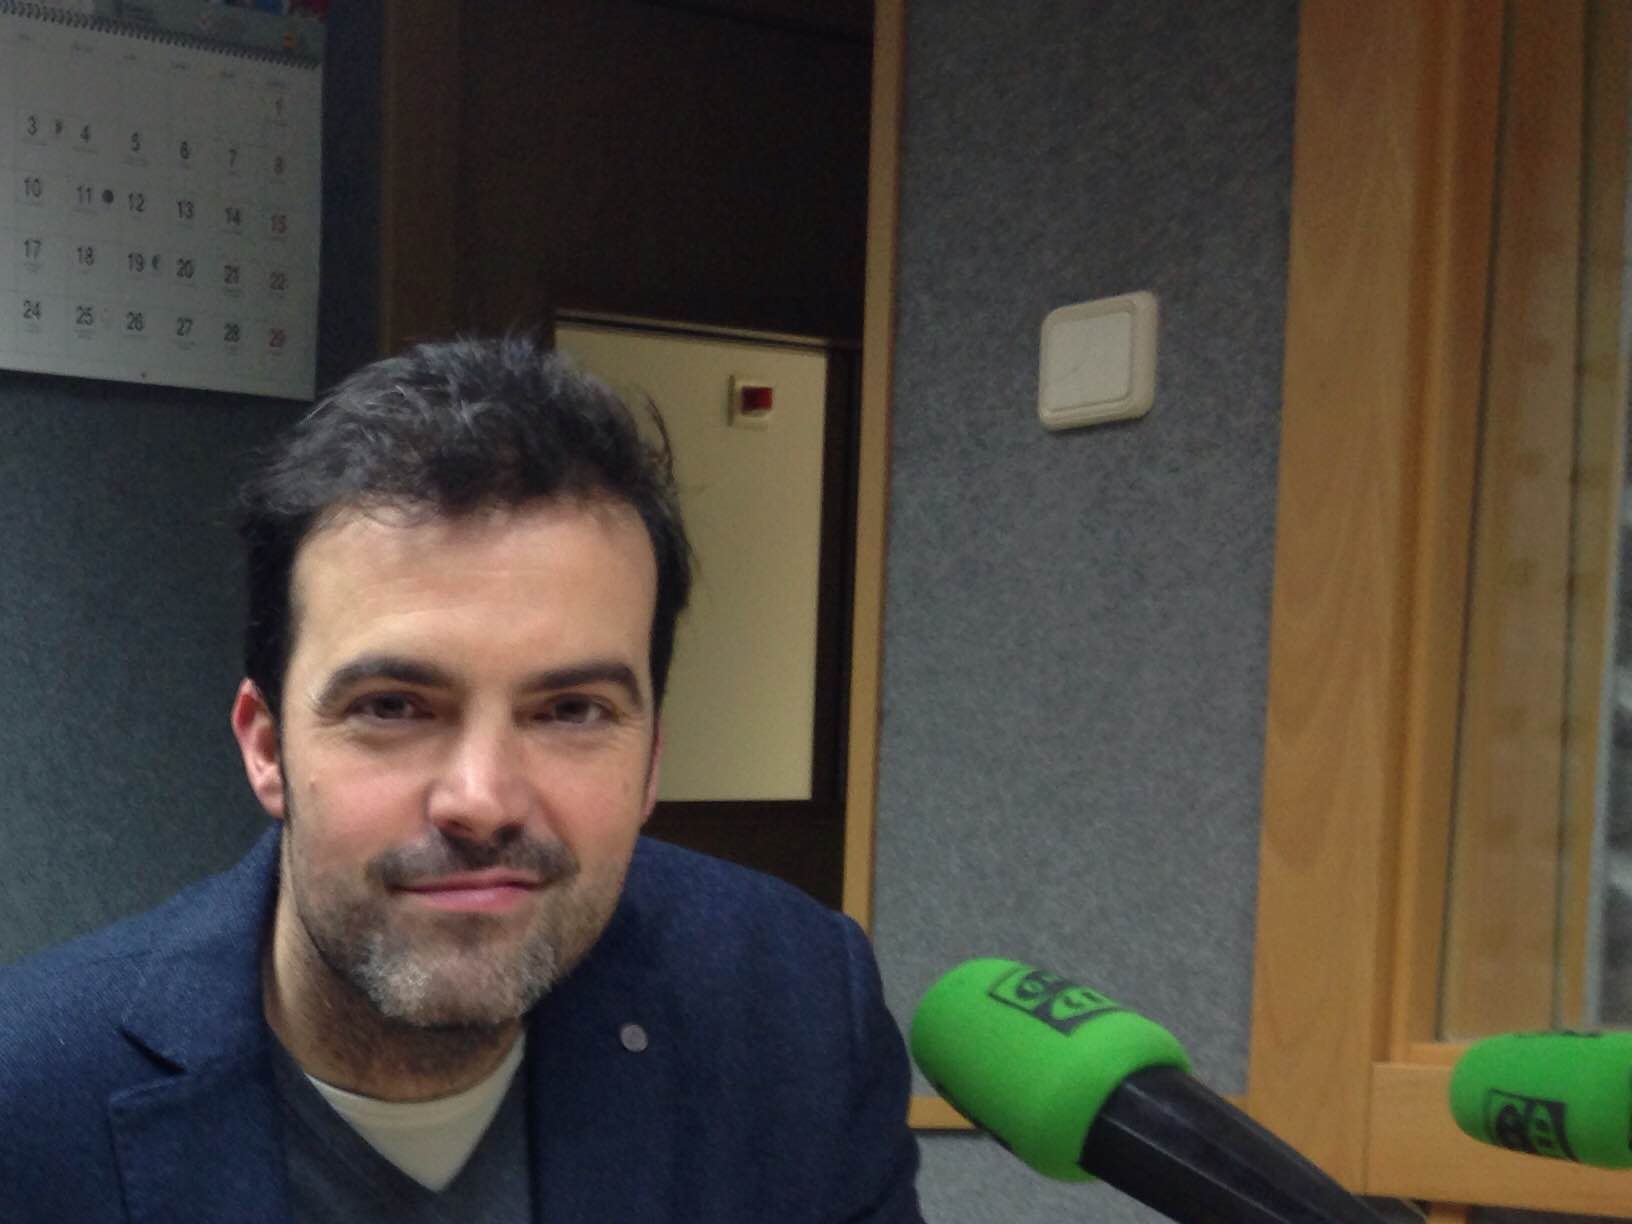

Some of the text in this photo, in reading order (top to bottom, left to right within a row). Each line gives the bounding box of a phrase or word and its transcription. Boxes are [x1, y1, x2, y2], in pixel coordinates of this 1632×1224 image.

[26, 114, 39, 136] 3
[79, 124, 91, 144] 4
[23, 176, 43, 198] 10
[76, 184, 93, 205] 11
[127, 191, 145, 213] 12
[177, 199, 195, 220] 13
[225, 206, 243, 226] 14
[23, 238, 43, 260] 17
[76, 245, 95, 266] 18
[127, 251, 145, 273] 19
[176, 257, 195, 279] 20
[23, 299, 42, 321] 24
[75, 304, 95, 326] 25
[125, 310, 145, 332] 26
[175, 316, 194, 337] 27
